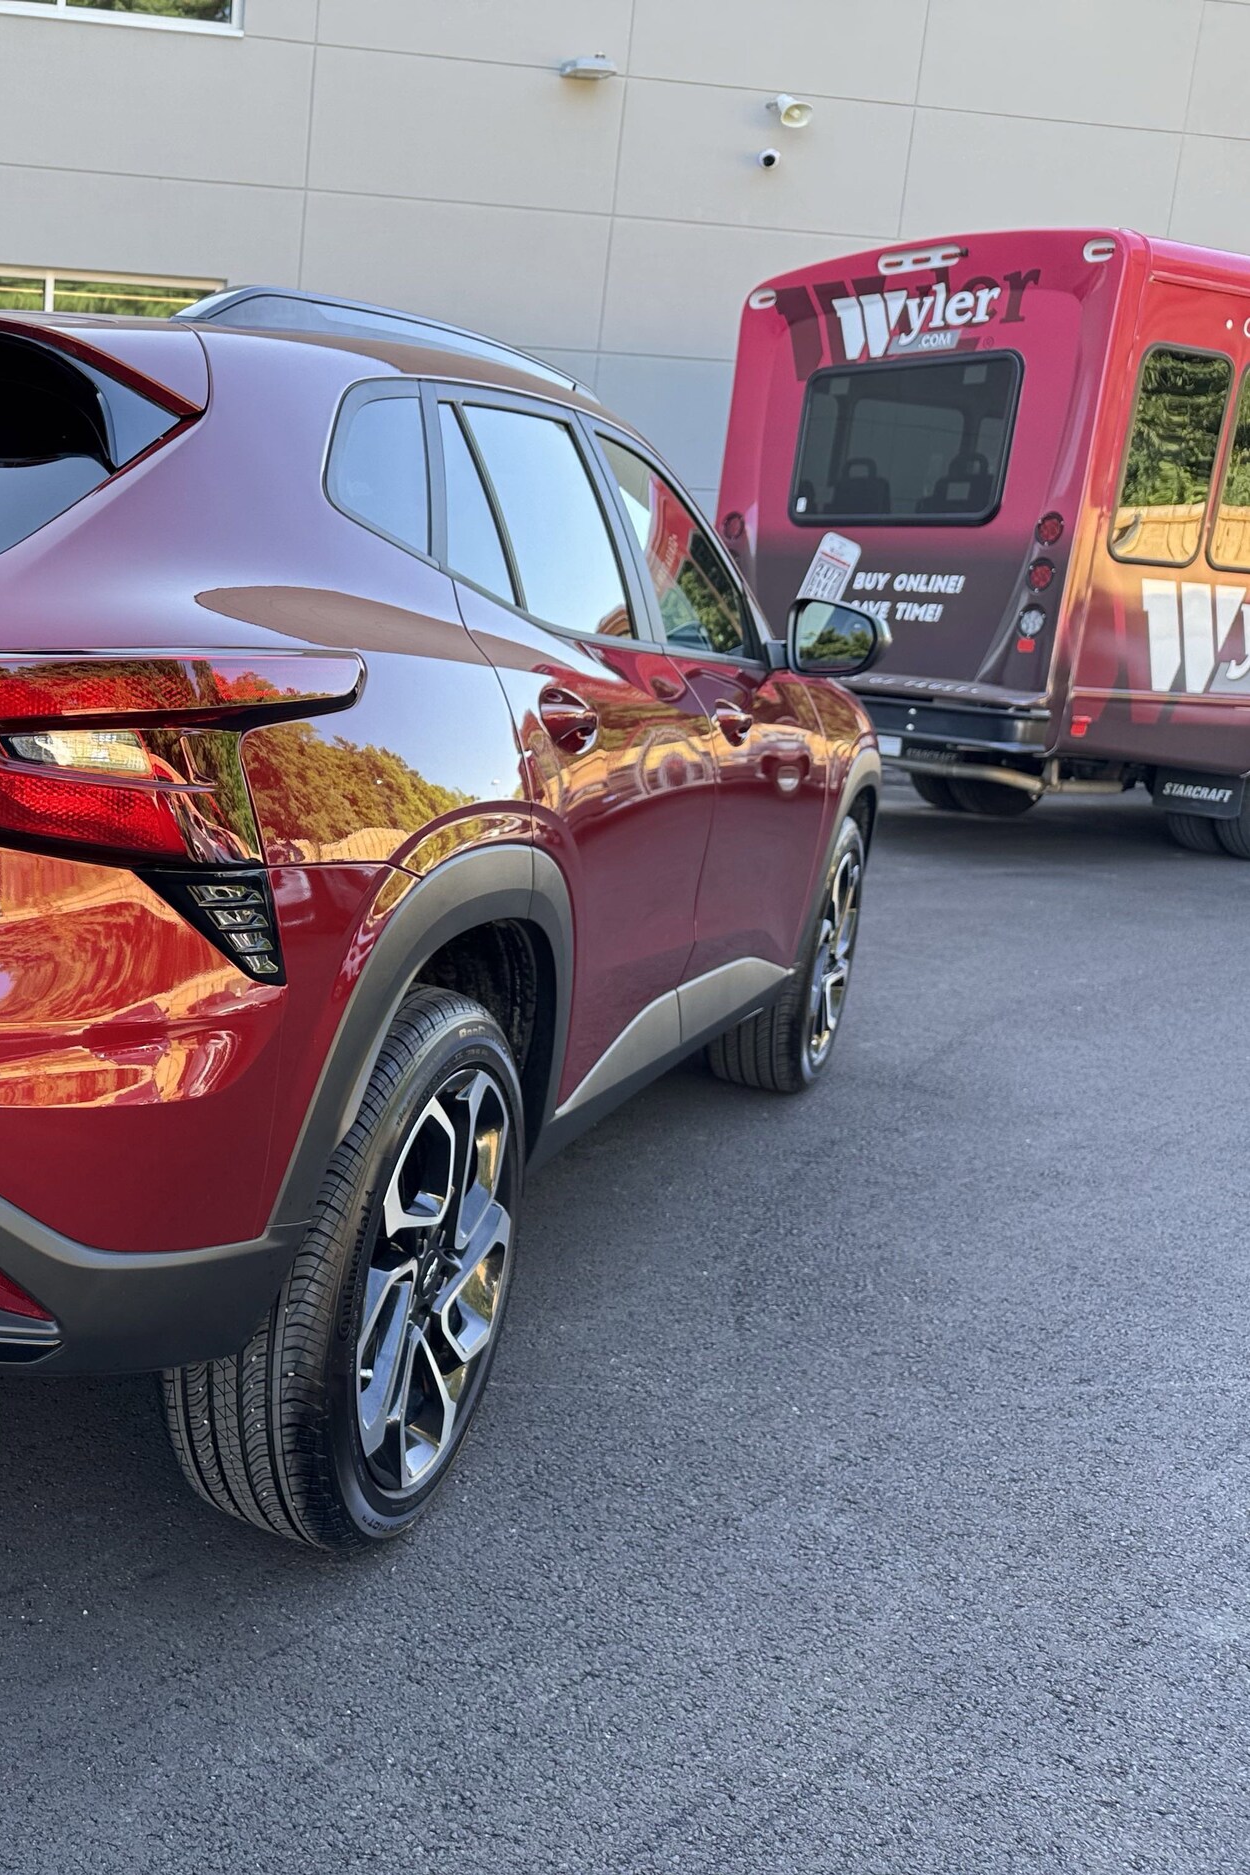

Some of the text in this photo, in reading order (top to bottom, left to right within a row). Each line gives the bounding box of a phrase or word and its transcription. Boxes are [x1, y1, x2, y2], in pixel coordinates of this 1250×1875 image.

[832, 282, 1001, 360] Wyler
[852, 572, 966, 594] BUY ONLINE!
[895, 602, 944, 622] TIME!
[1162, 781, 1234, 803] STARCRAFT
